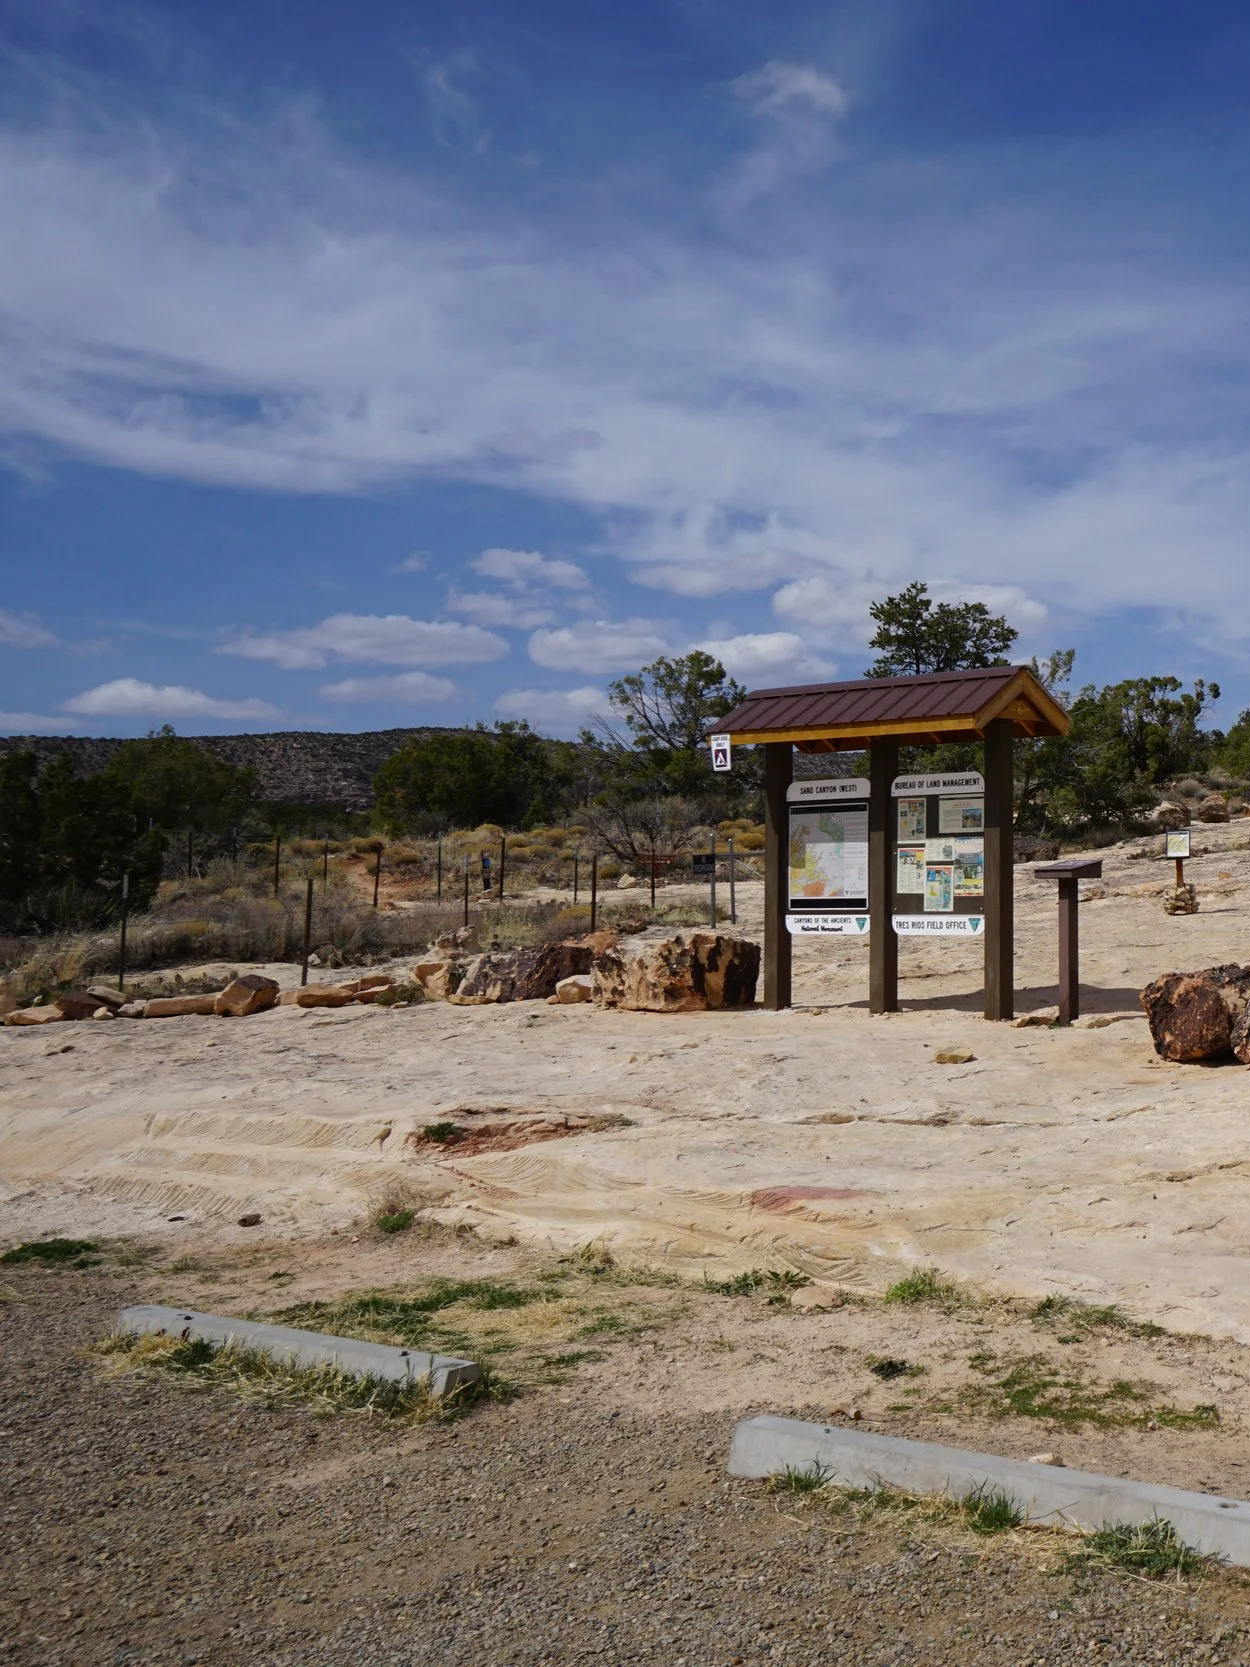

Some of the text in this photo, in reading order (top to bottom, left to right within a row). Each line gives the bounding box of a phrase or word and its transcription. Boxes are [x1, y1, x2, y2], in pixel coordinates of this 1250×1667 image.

[800, 784, 858, 795] SAND CANYON (WEST)
[895, 778, 981, 790] BUREAU OF LAND MANAGEMENT
[895, 921, 967, 929] TRES RIOS FIELD OFFICE
